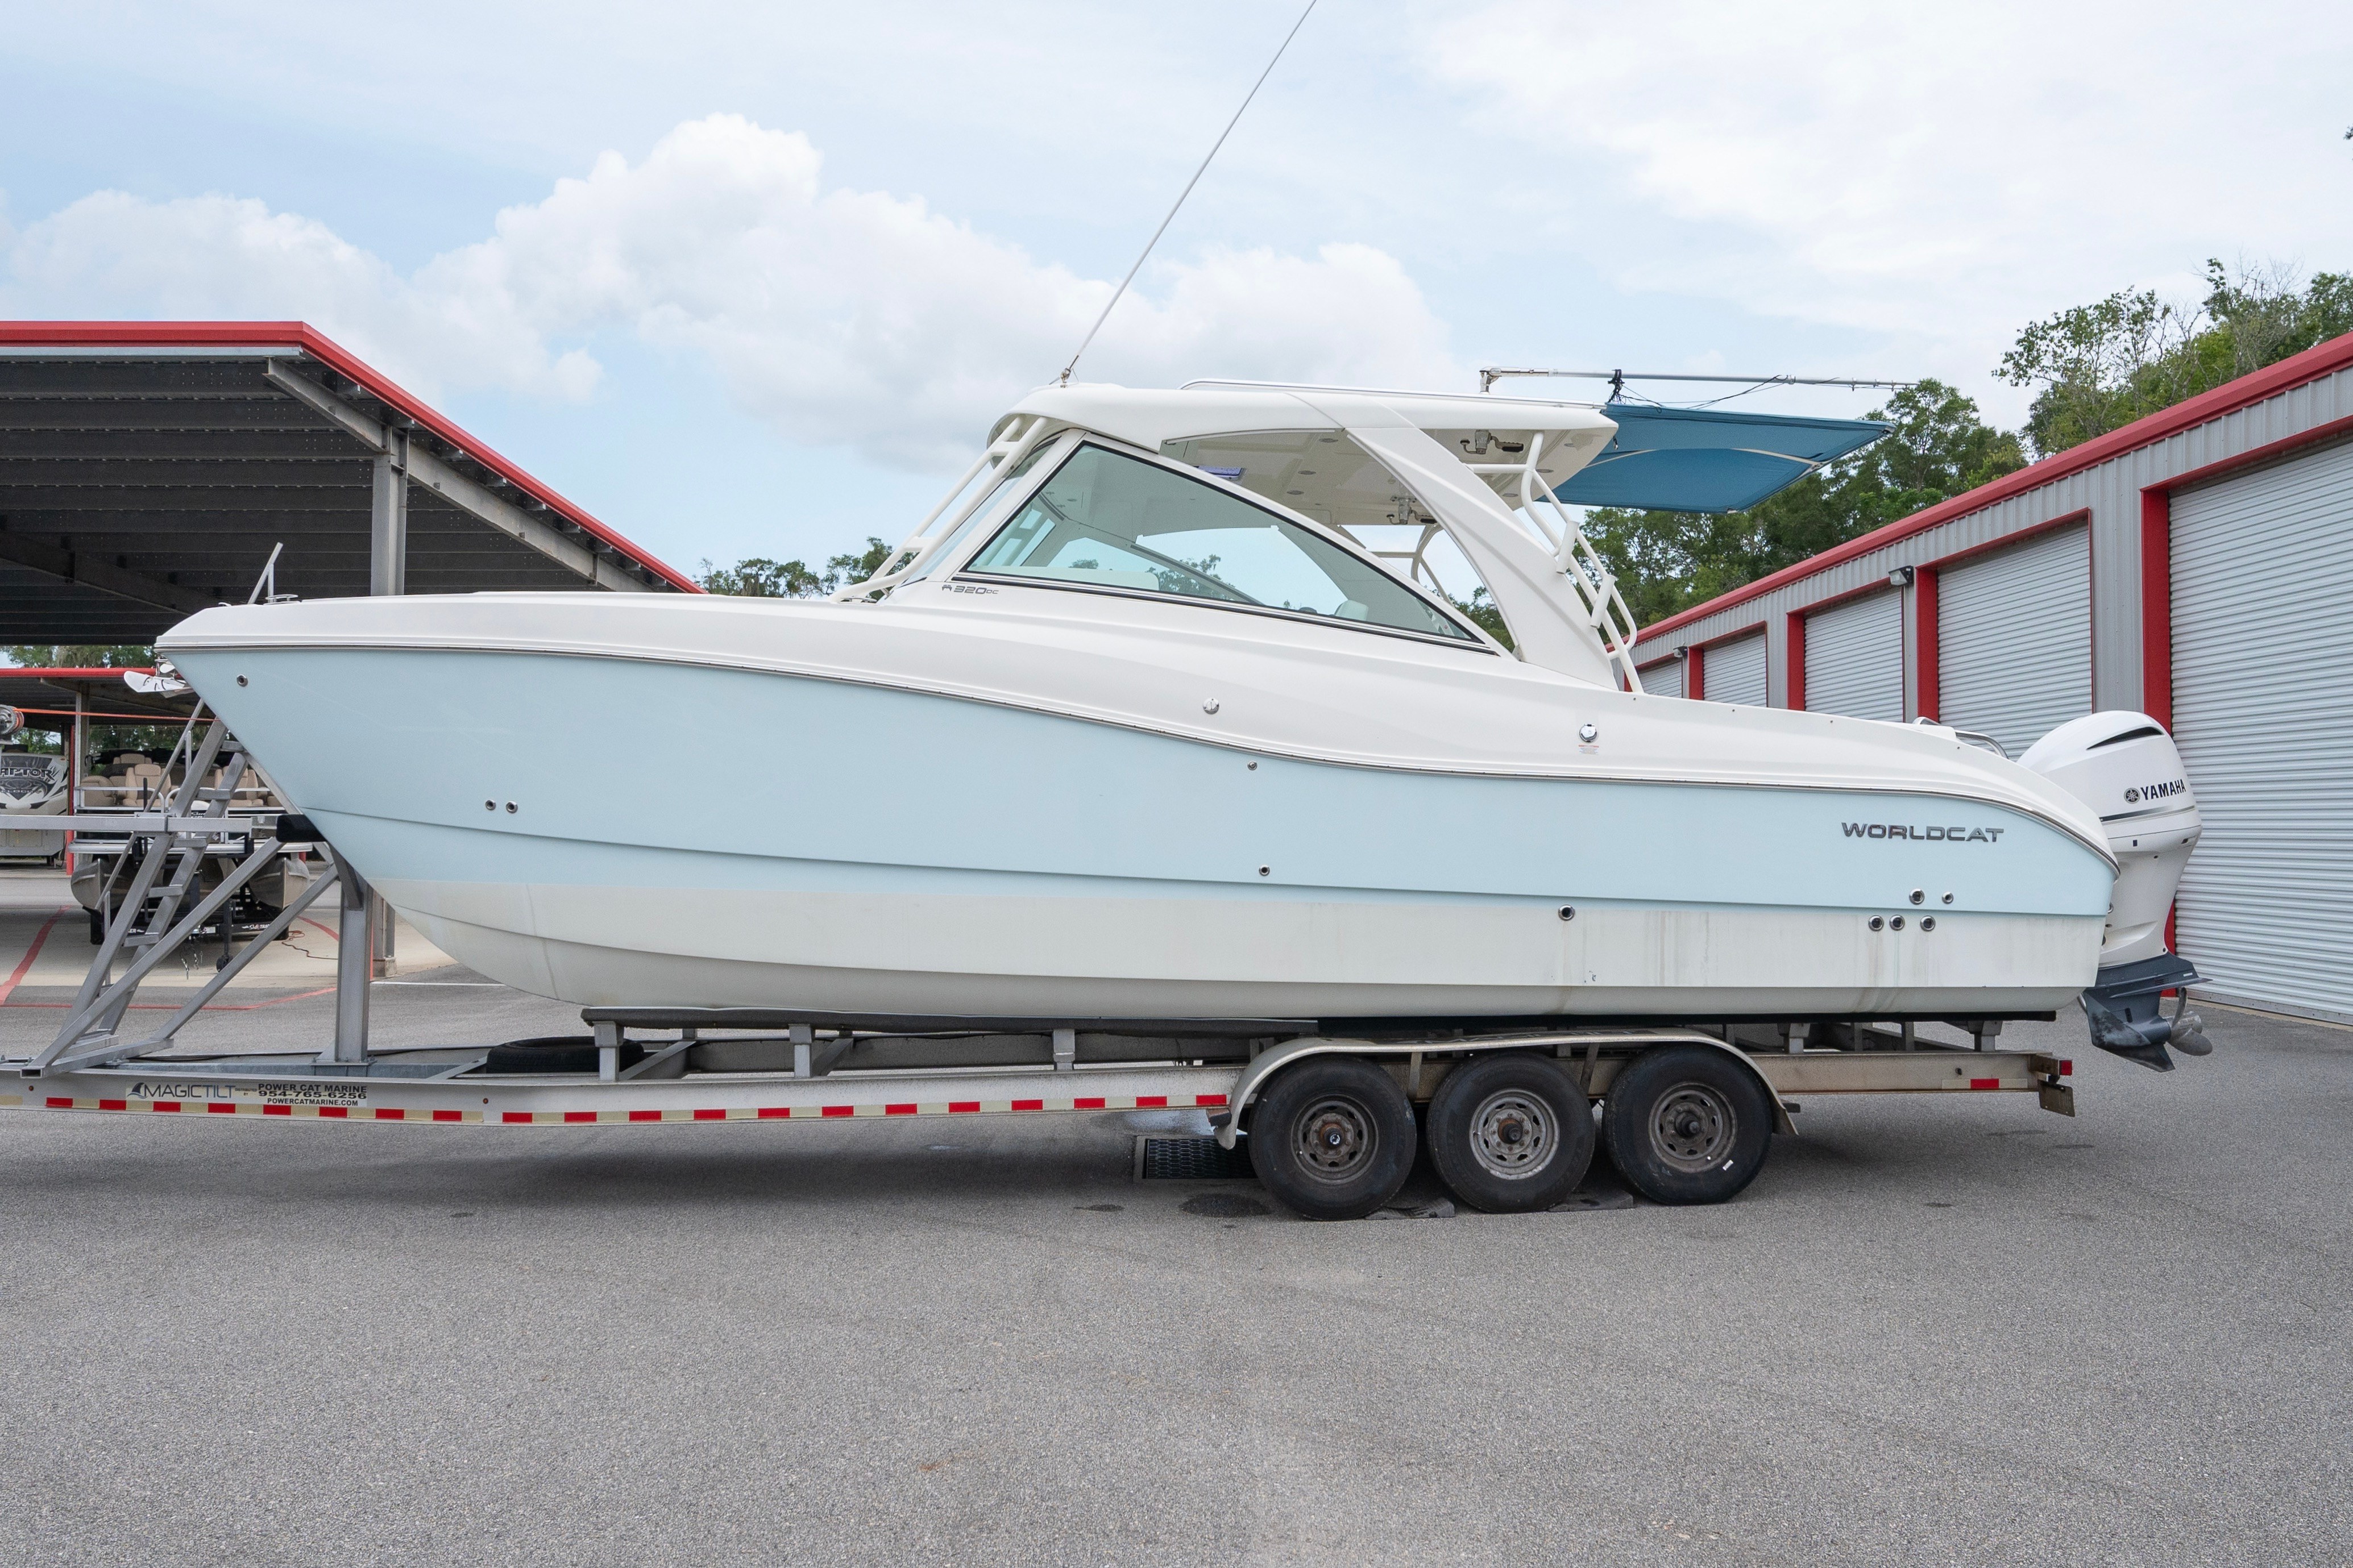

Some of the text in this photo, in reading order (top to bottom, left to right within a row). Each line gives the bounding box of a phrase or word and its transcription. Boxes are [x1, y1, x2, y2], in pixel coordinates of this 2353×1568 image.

[0, 767, 55, 781] APTOR
[2140, 779, 2186, 800] YAMAHA
[1841, 822, 2005, 842] WORLDCAT
[144, 1084, 236, 1099] MAGICTILT
[258, 1090, 367, 1099] 954-765-6256
